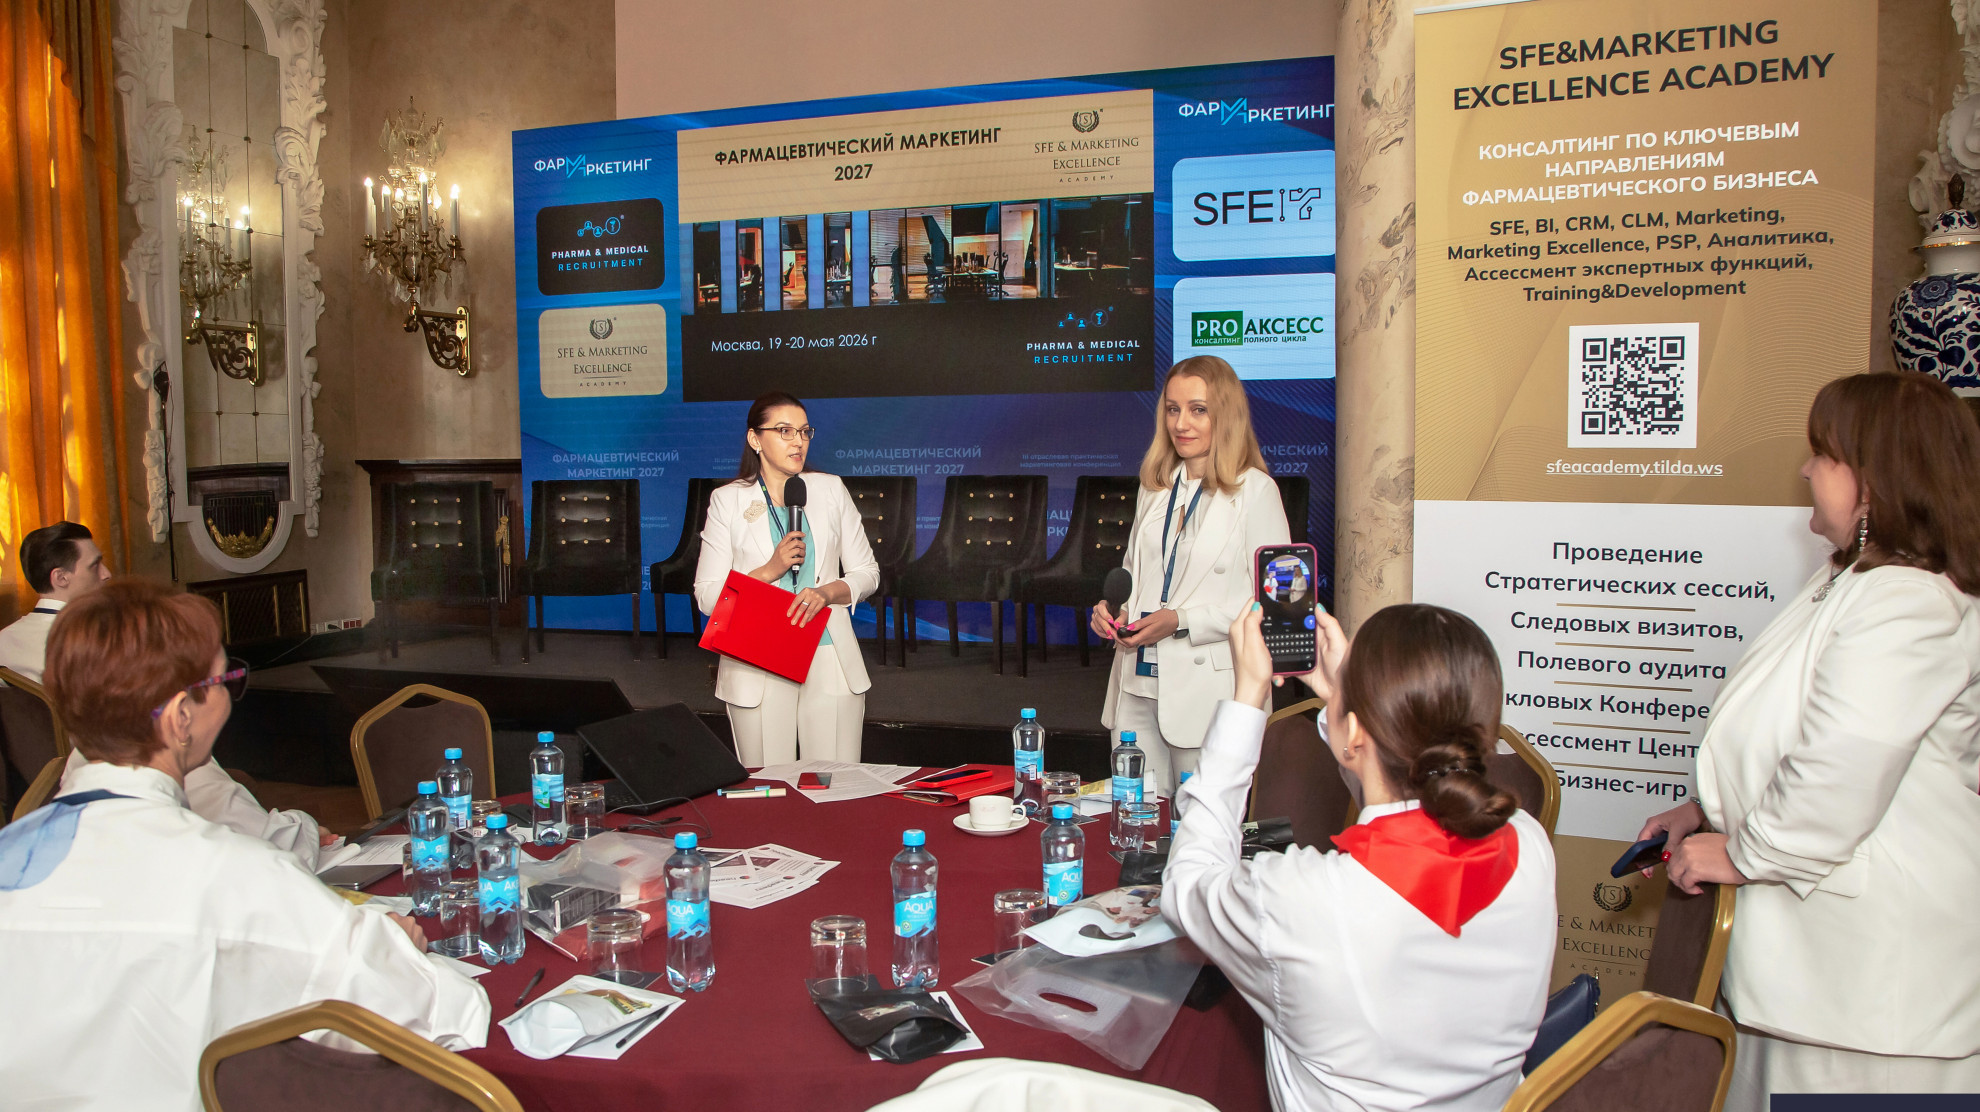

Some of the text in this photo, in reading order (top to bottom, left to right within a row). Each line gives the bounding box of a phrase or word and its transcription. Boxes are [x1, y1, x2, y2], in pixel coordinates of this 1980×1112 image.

[1499, 19, 1779, 70] SFE&MARKETING
[1454, 53, 1835, 110] EXCELLENCE ACADEMY
[715, 127, 1001, 167] ФАРМАЦЕВТИЧЕСКИЙ МАРКЕТИНГ
[1034, 137, 1140, 154] SFE & MARKETING
[1479, 121, 1799, 160] КОНСАЛТИНГ ПО КЛЮЧЕВЫМ
[1053, 156, 1121, 170] EXCELLENCE
[1545, 151, 1725, 178] НАПРАВЛЕНИЯМ
[834, 164, 873, 181] 2027
[1059, 175, 1115, 183] ACADEMY
[1462, 169, 1819, 207] ФАРМАЦЕВТИЧЕСКОГО БИЗНЕСА
[1490, 206, 1785, 237] SFE, BI, CRM, CLM, Marketing,
[551, 245, 649, 260] PHARMA & MEDICAL
[1447, 228, 1834, 261] Marketing Excellence, PSP, Аналитика,
[558, 259, 644, 272] RECRUITMENT
[1464, 253, 1813, 282] Ассессмент экспертных функций,
[1523, 280, 1746, 304] Training&Development
[1196, 319, 1238, 337] PRO
[711, 338, 764, 352] Москва,
[768, 337, 781, 349] 19
[808, 338, 835, 348] мая
[838, 334, 867, 347] 2026
[871, 337, 877, 346] г
[1026, 339, 1140, 351] PHARMA & MEDICAL
[1194, 334, 1307, 345] консалтинг полного цикла
[557, 347, 575, 359] SFE
[588, 345, 648, 357] MARKETING
[1034, 353, 1133, 364] RECRUITMENT
[574, 362, 632, 374] EXCELLENCE
[552, 449, 679, 464] ФАРМАЦЕВТИЧЕСКИЙ
[835, 445, 981, 460] ФАРМАЦЕВТИЧЕСКИЙ
[1261, 442, 1328, 456] ИЧЕСКИЙ
[567, 467, 665, 478] МАРКЕТИНГ 2027
[852, 464, 964, 475] МАРКЕТИНГ 2027
[1274, 462, 1309, 474] 2027
[1546, 459, 1723, 477] sfeacademy.tilda.ws
[1553, 542, 1703, 566] Проведение
[1485, 571, 1775, 602] Стратегических сессий,
[1510, 611, 1743, 641] Следовых визитов,
[1518, 651, 1727, 680] Полевого аудита
[1505, 693, 1710, 722] кловых Конфере
[1523, 732, 1699, 759] сессмент Цент
[904, 900, 934, 914] AQUA
[1570, 917, 1583, 930] &
[1589, 919, 1656, 938] MARKET
[1563, 938, 1651, 960] EXCELLENC
[1570, 963, 1636, 976] ACADEM
